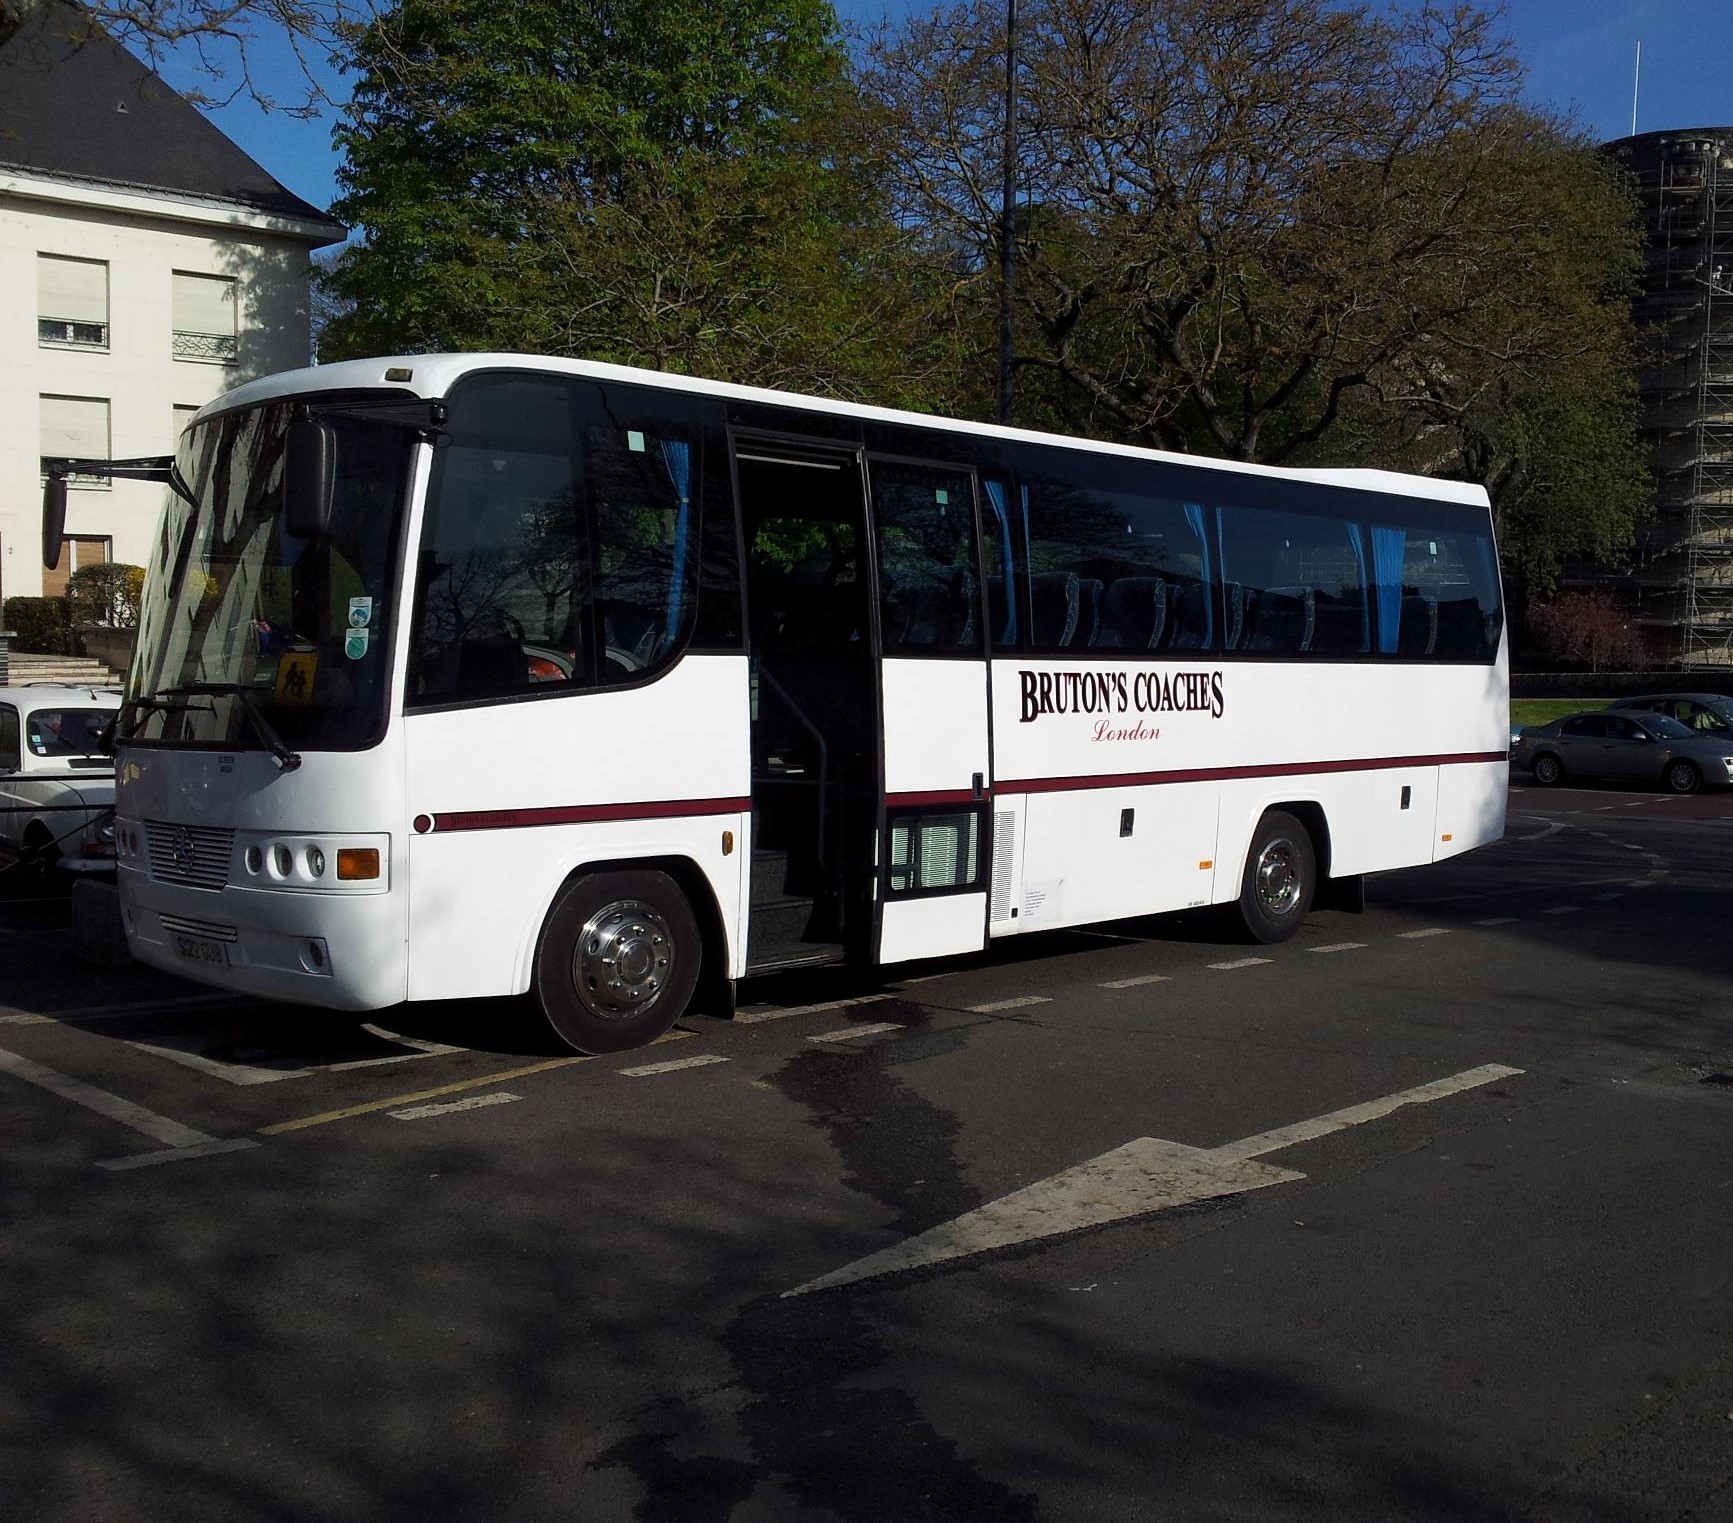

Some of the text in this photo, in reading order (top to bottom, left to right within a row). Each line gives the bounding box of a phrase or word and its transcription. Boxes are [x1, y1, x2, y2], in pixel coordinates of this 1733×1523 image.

[1018, 670, 1224, 723] BRUTON'S COACHES
[1091, 719, 1160, 742] London
